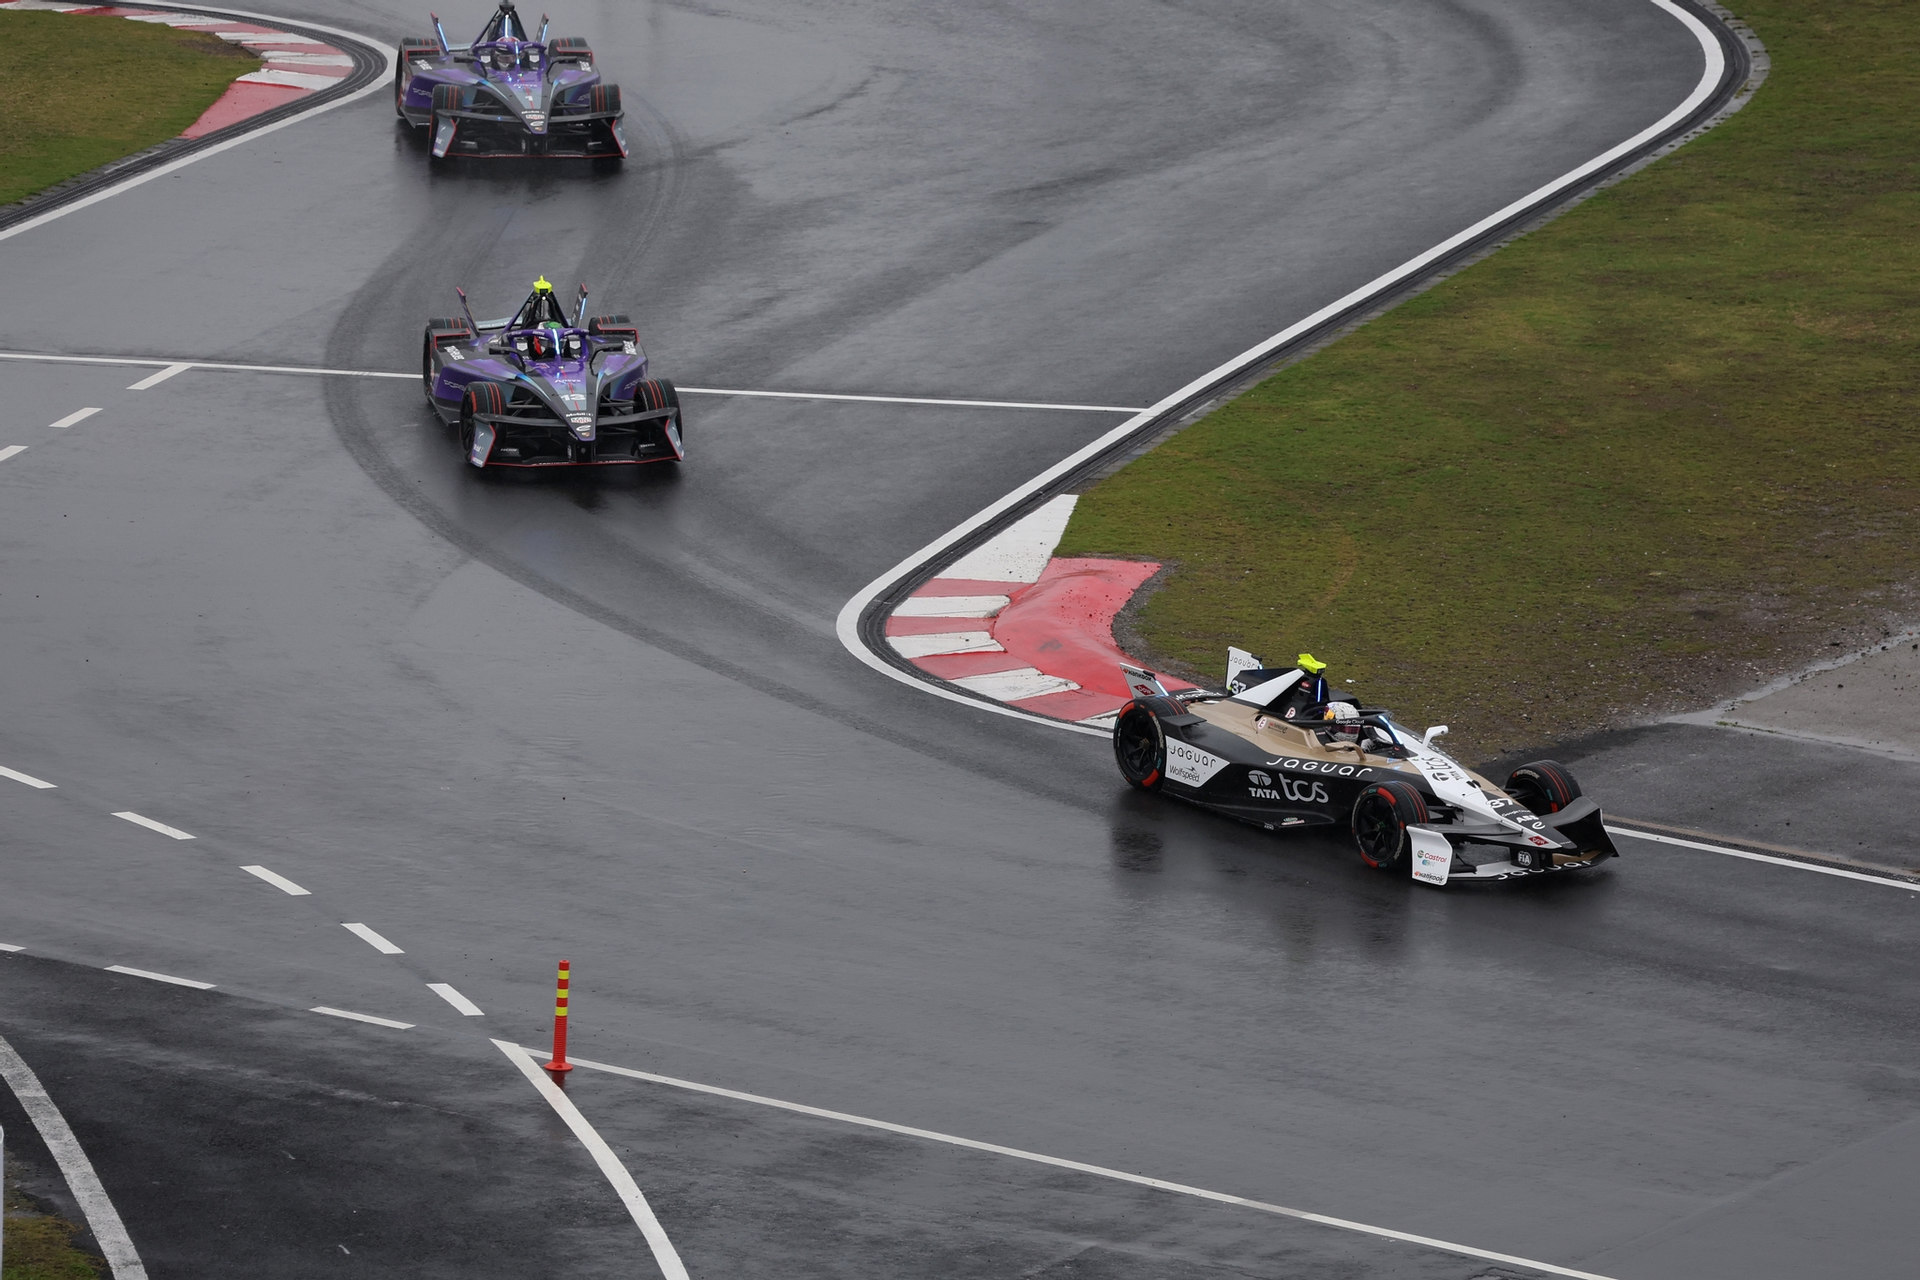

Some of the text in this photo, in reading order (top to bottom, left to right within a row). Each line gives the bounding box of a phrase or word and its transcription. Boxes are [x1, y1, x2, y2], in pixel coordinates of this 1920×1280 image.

[1231, 680, 1246, 694] 37
[1248, 772, 1329, 803] TATA tcs
[1424, 852, 1447, 863] Castrol
